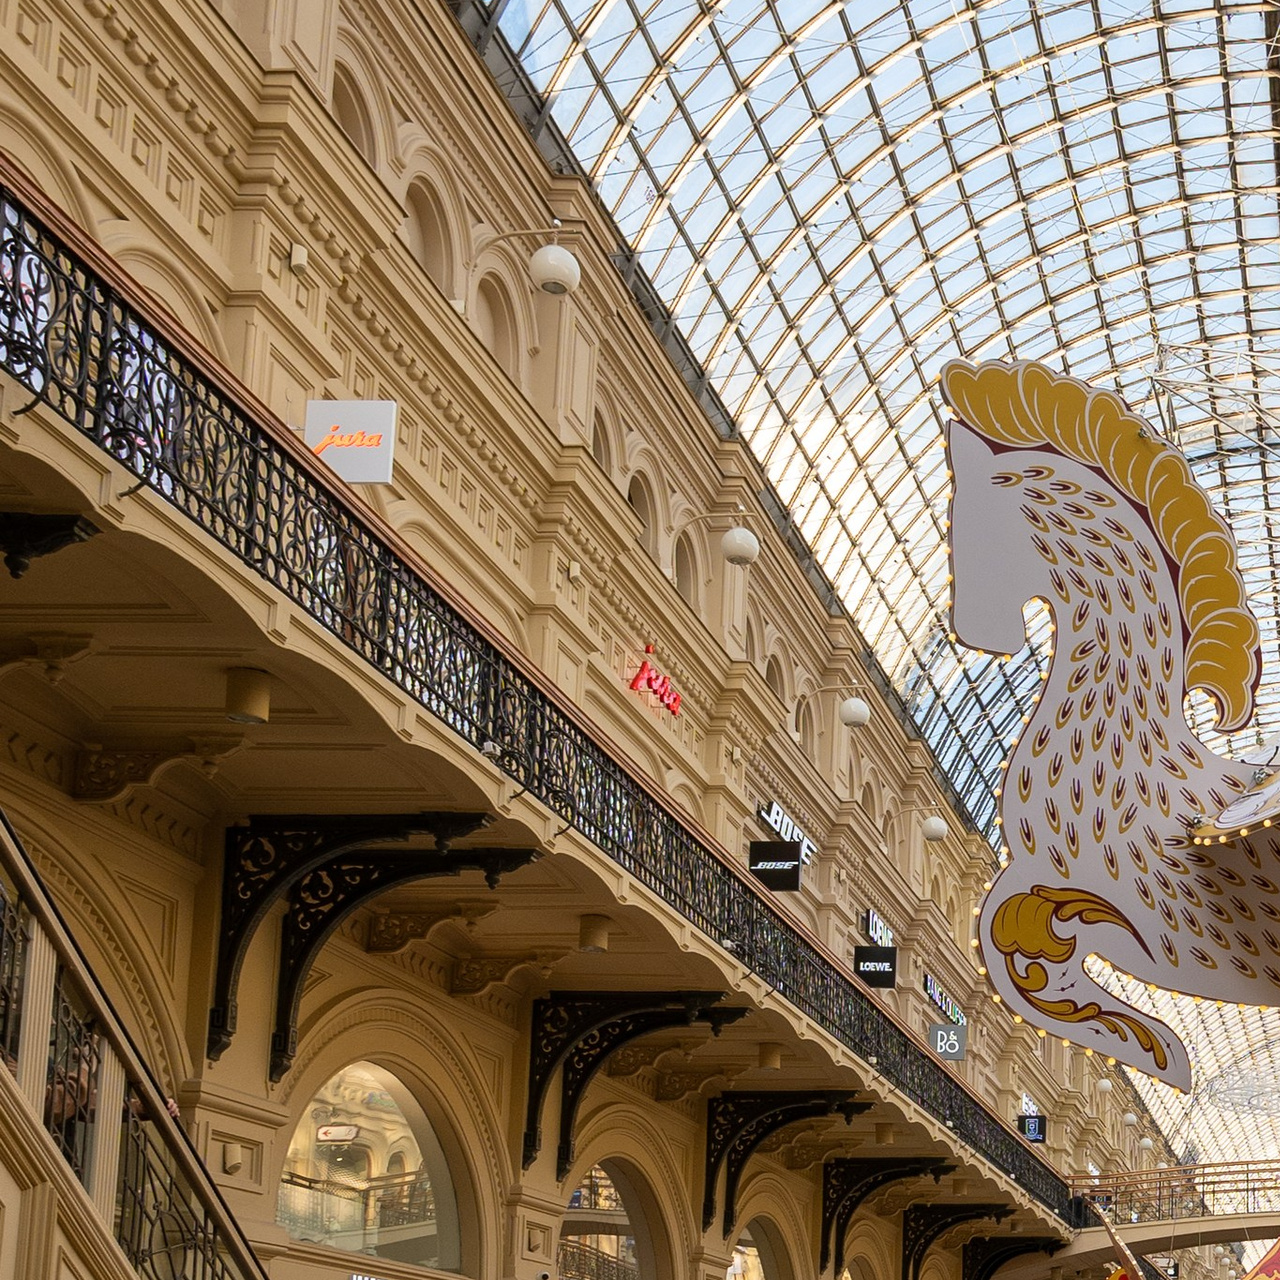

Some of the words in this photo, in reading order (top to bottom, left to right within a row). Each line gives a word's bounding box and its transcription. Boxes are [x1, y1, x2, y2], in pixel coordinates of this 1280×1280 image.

[312, 424, 383, 456] jura
[760, 801, 818, 866] BOSE
[750, 861, 799, 870] BOSE
[859, 961, 893, 971] LOEWE.
